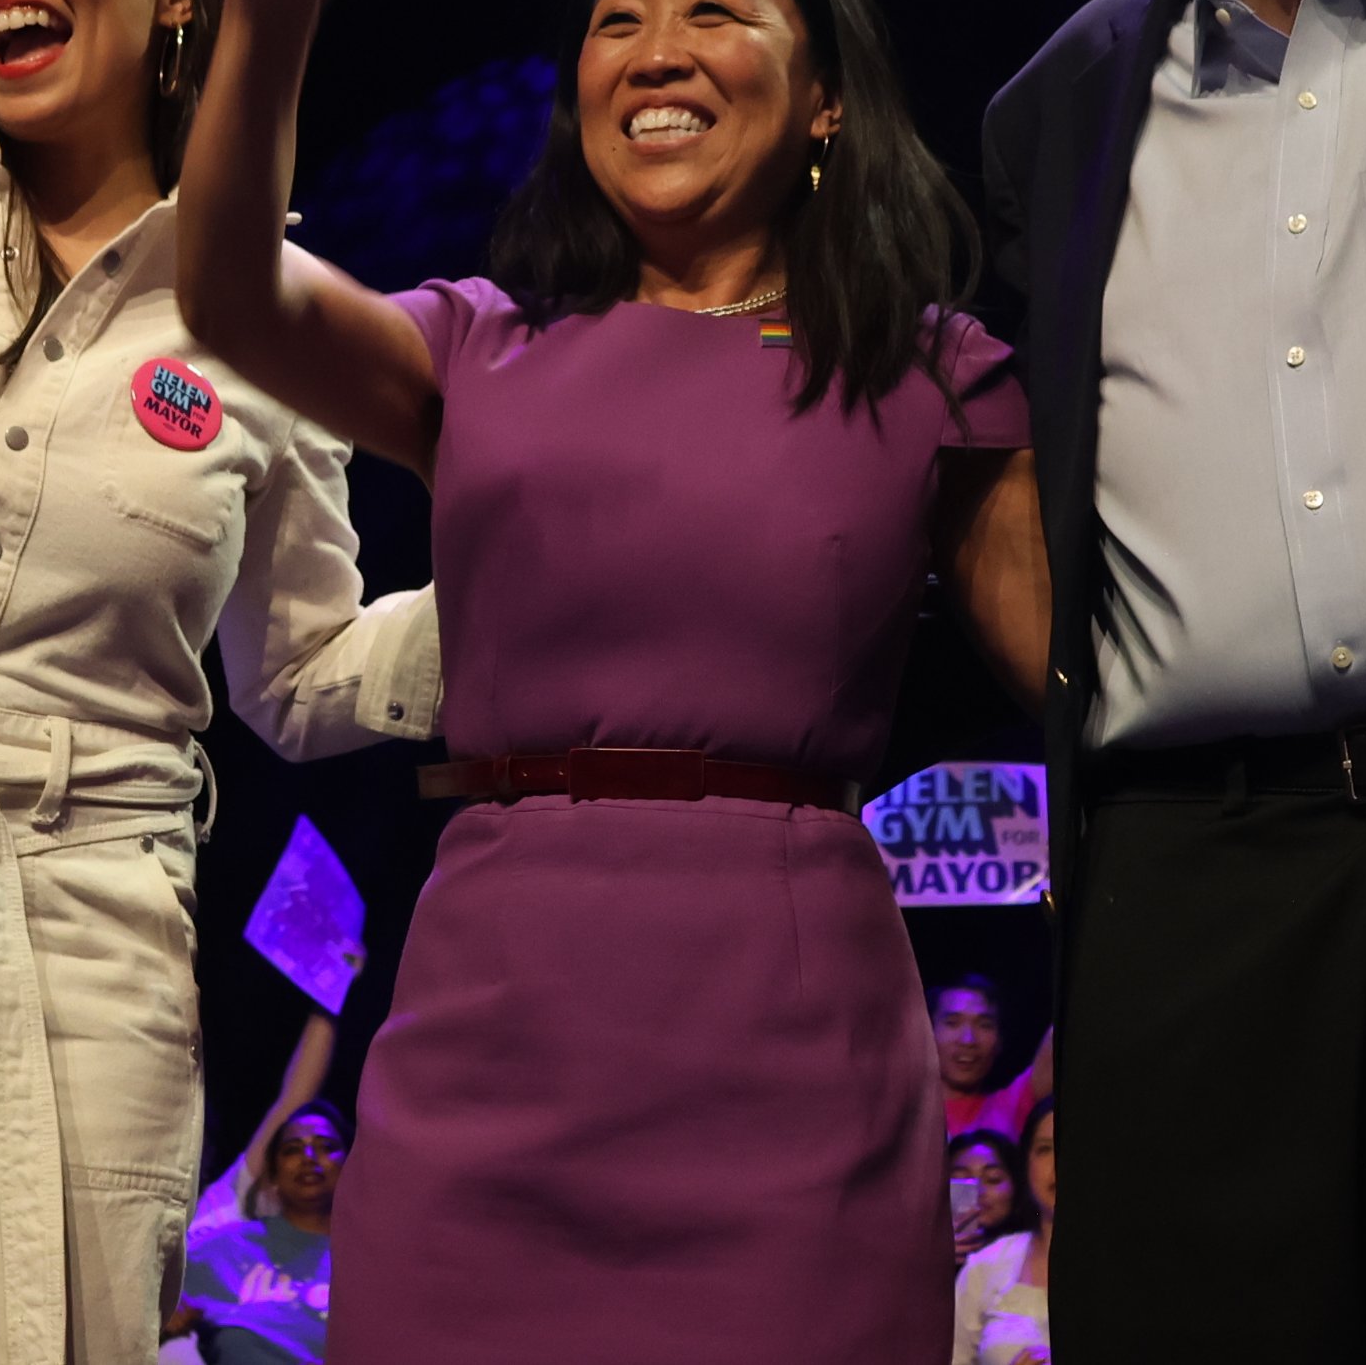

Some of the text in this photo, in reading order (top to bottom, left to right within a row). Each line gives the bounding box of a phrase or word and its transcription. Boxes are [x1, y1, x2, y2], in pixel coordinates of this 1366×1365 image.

[150, 378, 191, 412] GYM
[153, 364, 210, 408] HELEN
[143, 397, 202, 439] MAYOR
[871, 803, 986, 847] GYM
[1002, 829, 1040, 844] FOR
